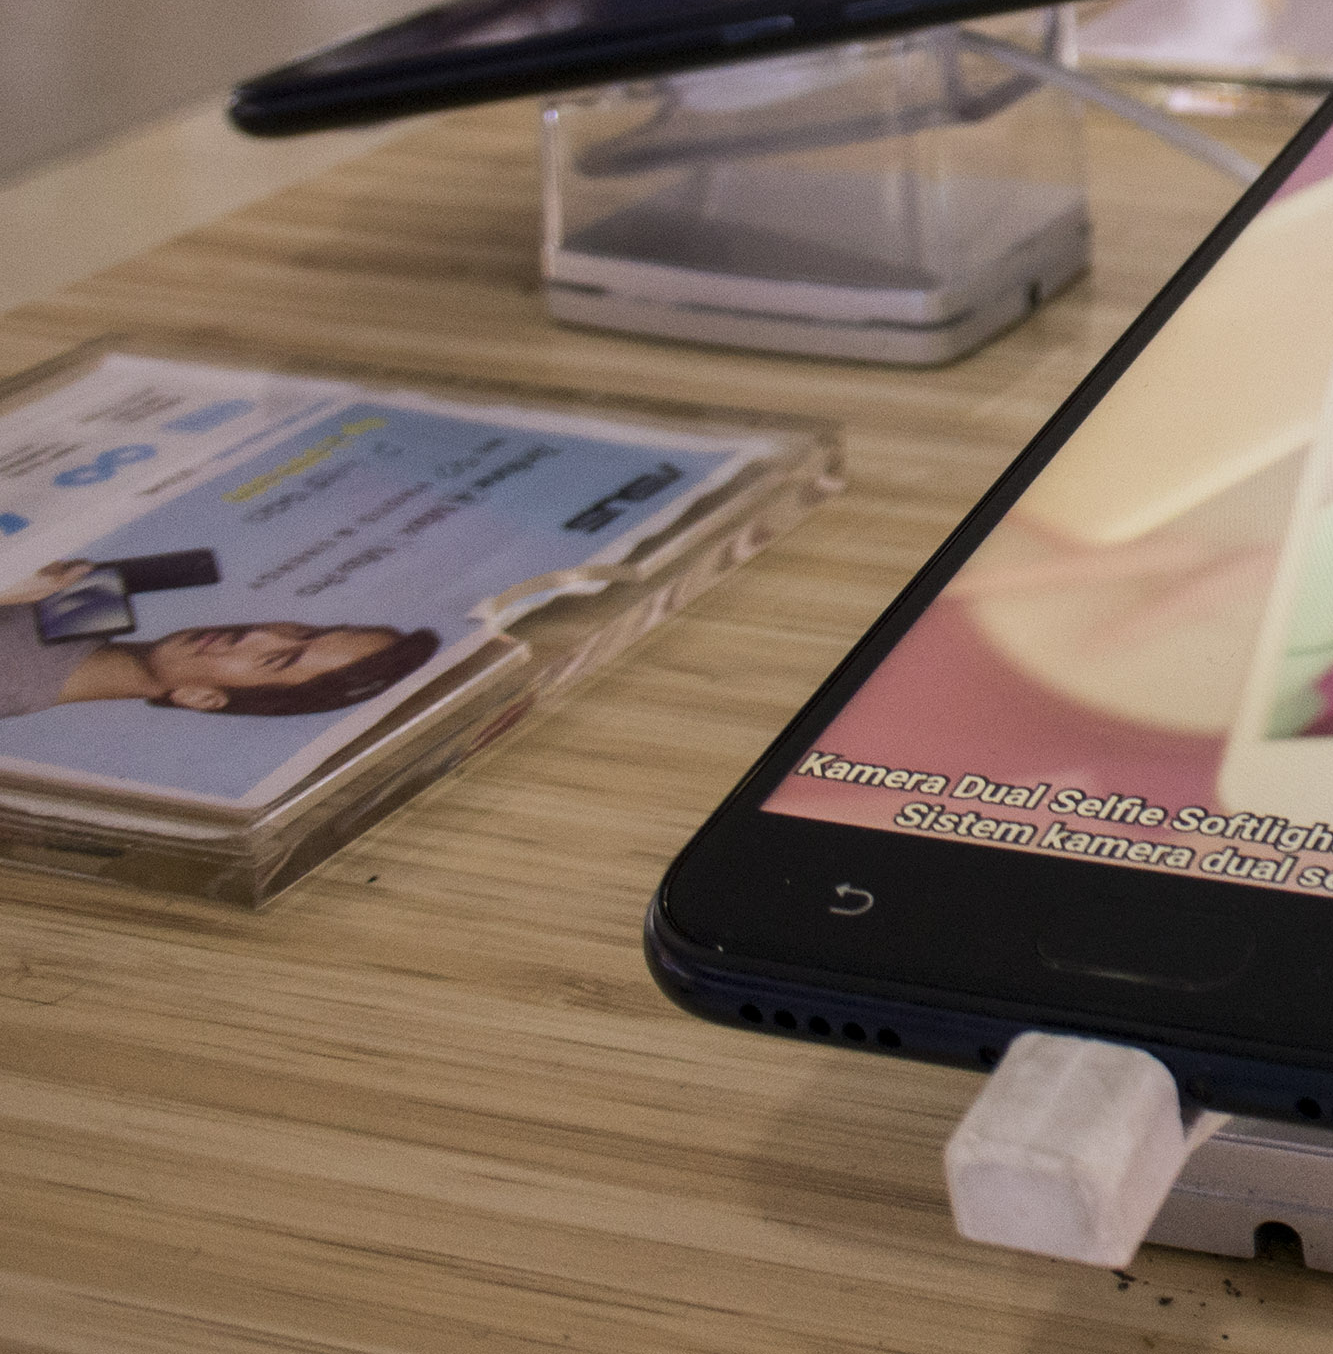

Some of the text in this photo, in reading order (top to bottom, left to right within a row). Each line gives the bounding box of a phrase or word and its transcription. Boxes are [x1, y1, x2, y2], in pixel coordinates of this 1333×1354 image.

[797, 751, 949, 795] Kamera
[952, 774, 1049, 811] Dual
[1050, 787, 1166, 830] Selfie
[895, 802, 1036, 845] Sistem
[1041, 822, 1194, 870] kamera
[1201, 845, 1297, 884] dual
